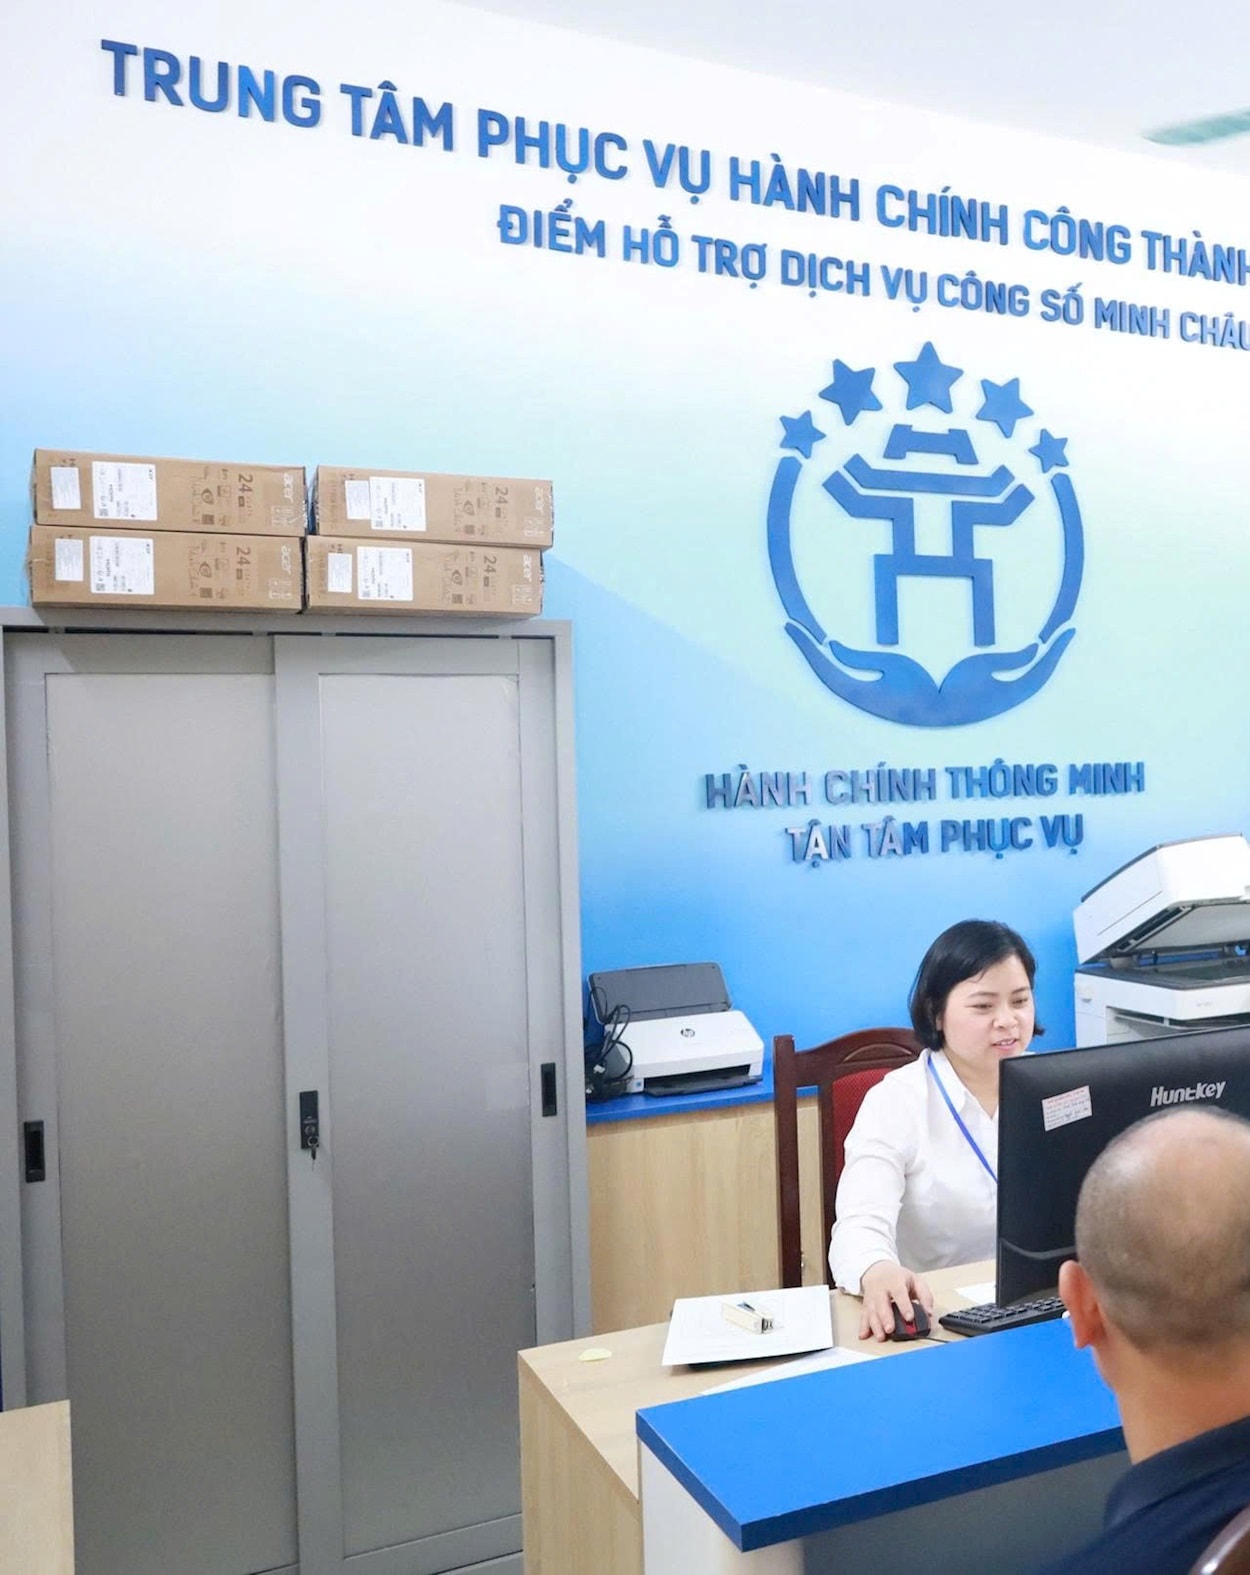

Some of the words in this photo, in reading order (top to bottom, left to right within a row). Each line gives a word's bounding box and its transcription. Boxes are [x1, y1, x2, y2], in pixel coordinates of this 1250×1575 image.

[101, 39, 322, 128] TRUNG
[340, 80, 453, 151] TÂM
[478, 109, 627, 184] PHỤC
[643, 140, 710, 205] VỤ
[730, 153, 860, 221] HÀNH
[876, 186, 1008, 245] CHÍNH
[1023, 206, 1131, 264] CÔNG
[497, 199, 605, 258] ĐIỂM
[623, 215, 679, 267] HỖ
[691, 235, 767, 289] TRỢ
[781, 249, 870, 297] DỊCH
[881, 265, 927, 312] VỤ
[937, 271, 1029, 317] CÔNG
[1041, 282, 1083, 325] SỐ
[1095, 298, 1169, 338] MINH
[238, 474, 253, 494] 24
[236, 546, 251, 566] 24
[705, 764, 812, 809] HÀNH
[825, 762, 936, 805] CHÍNH
[945, 758, 1058, 799] THÔNG
[1069, 762, 1145, 796] MINH
[785, 819, 851, 868] TẬN
[861, 815, 929, 858] TÂM
[941, 817, 1033, 860] PHỤC
[1040, 814, 1083, 855] VỤ
[1150, 1081, 1226, 1107] Huntkey
